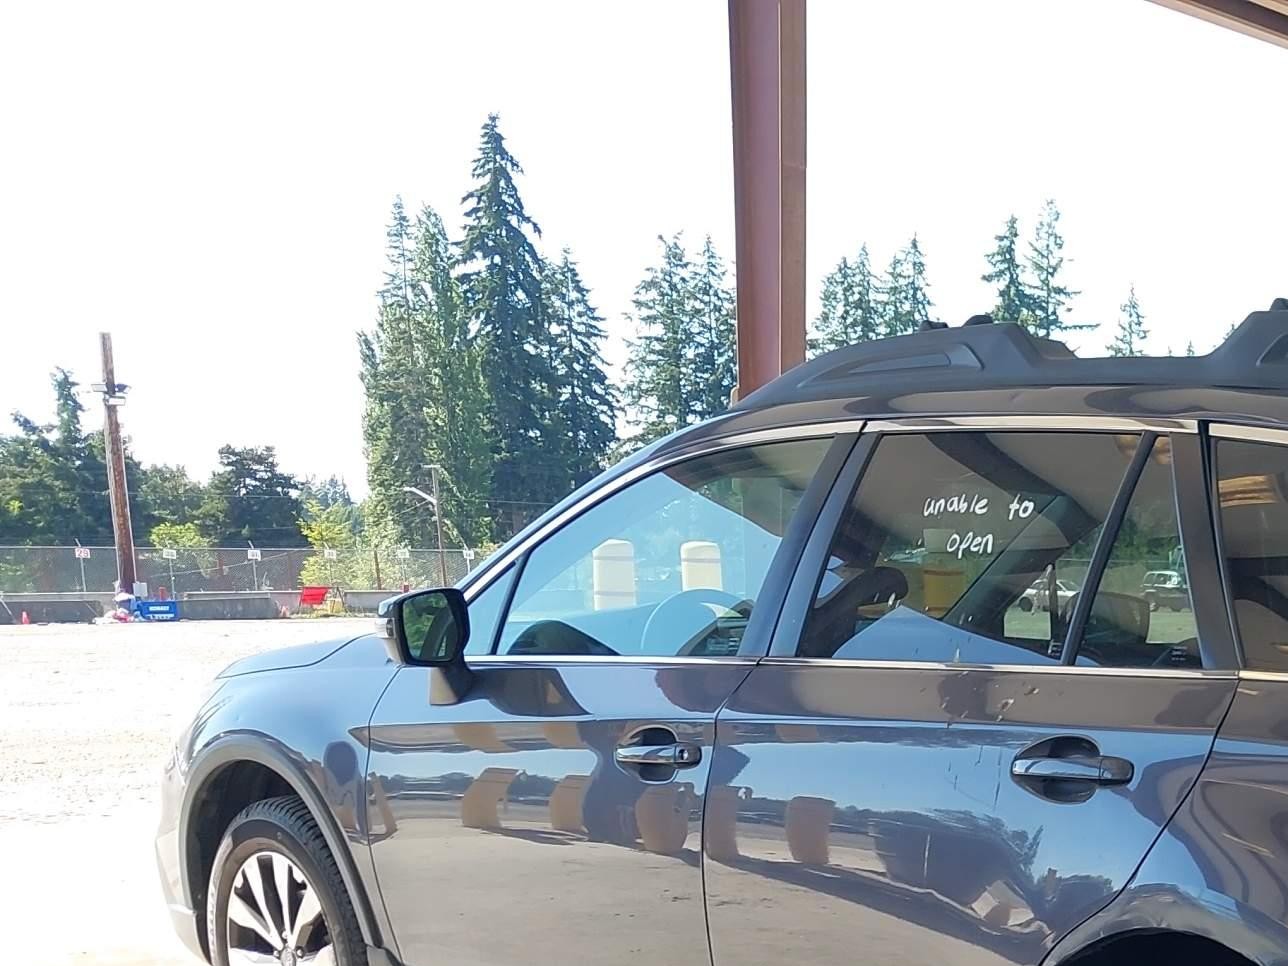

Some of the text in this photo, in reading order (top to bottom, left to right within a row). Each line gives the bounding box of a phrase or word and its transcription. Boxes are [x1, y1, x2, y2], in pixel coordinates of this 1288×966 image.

[923, 493, 1035, 520] unable to
[946, 531, 994, 559] open
